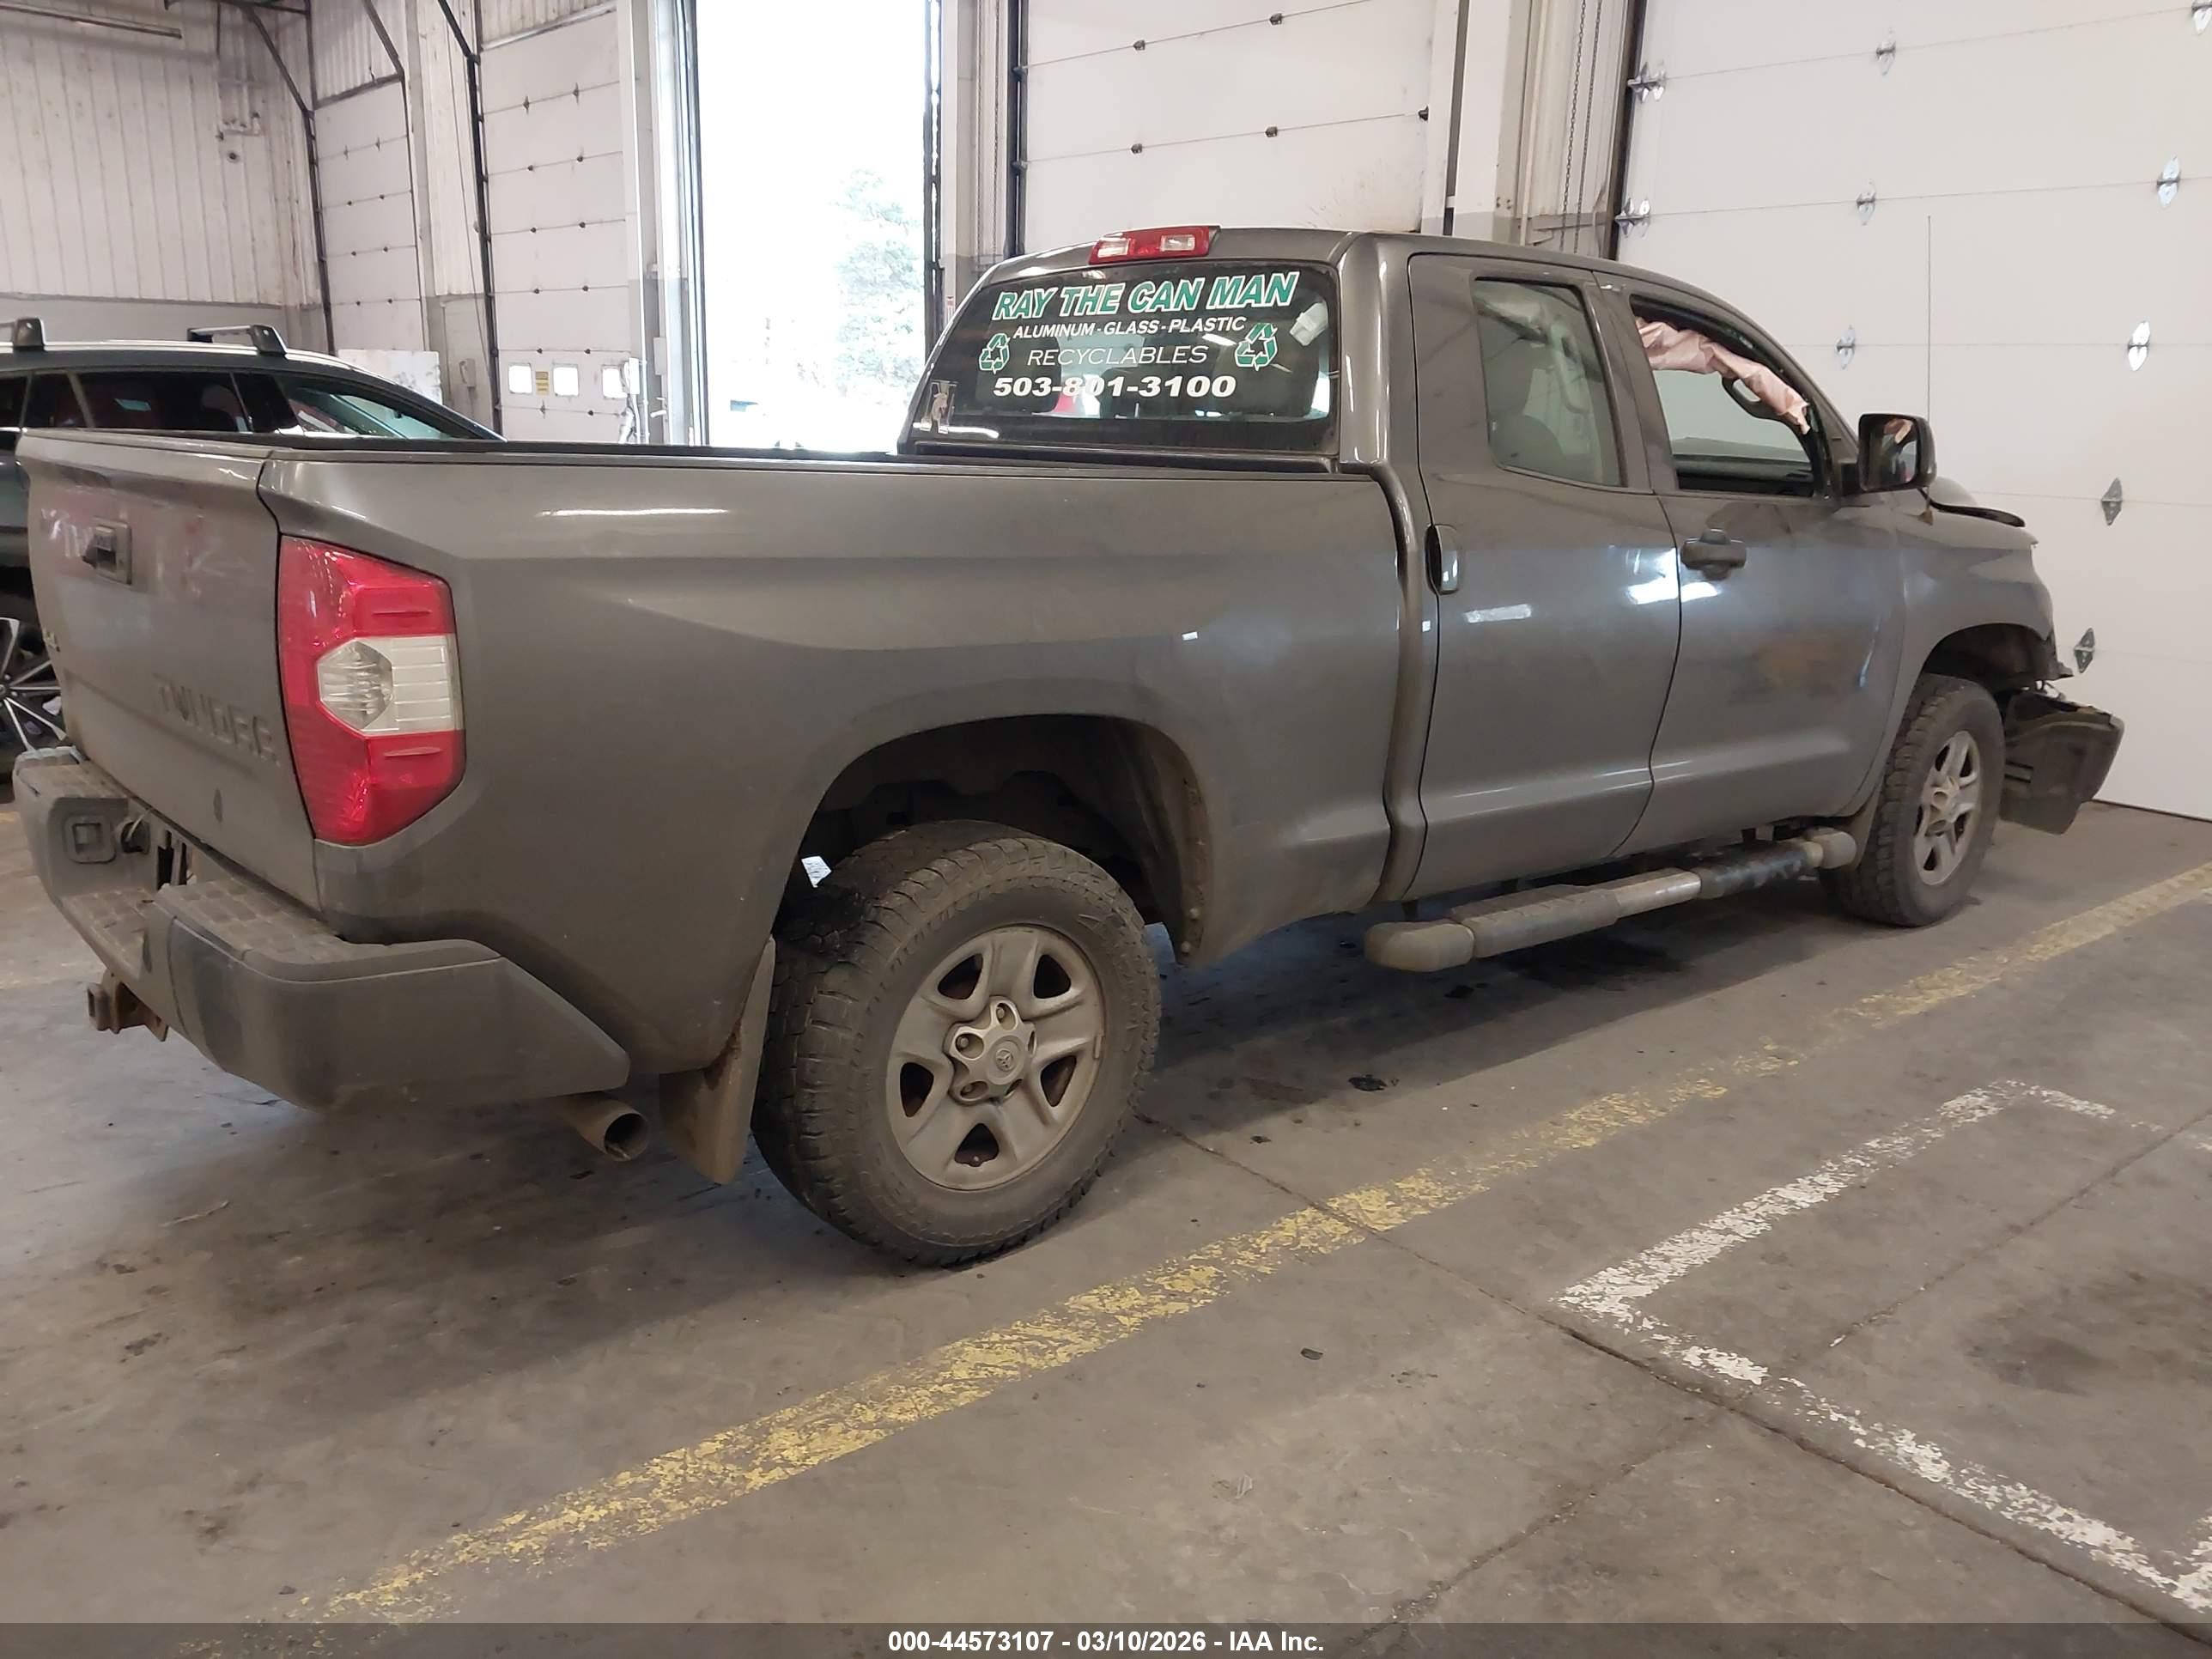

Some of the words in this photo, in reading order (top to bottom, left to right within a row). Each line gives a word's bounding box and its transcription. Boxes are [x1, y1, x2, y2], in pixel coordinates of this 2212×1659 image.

[992, 288, 1058, 320] RAY
[1059, 283, 1126, 317] THE
[1127, 277, 1205, 313] CAN
[1206, 271, 1300, 309] MAN
[1012, 322, 1096, 339] ALUMINUM
[1103, 320, 1160, 335] GLASS
[1168, 317, 1247, 333] PLASTIC
[1027, 345, 1209, 366] RECYCLABLES
[993, 376, 1237, 398] 503-801-3100
